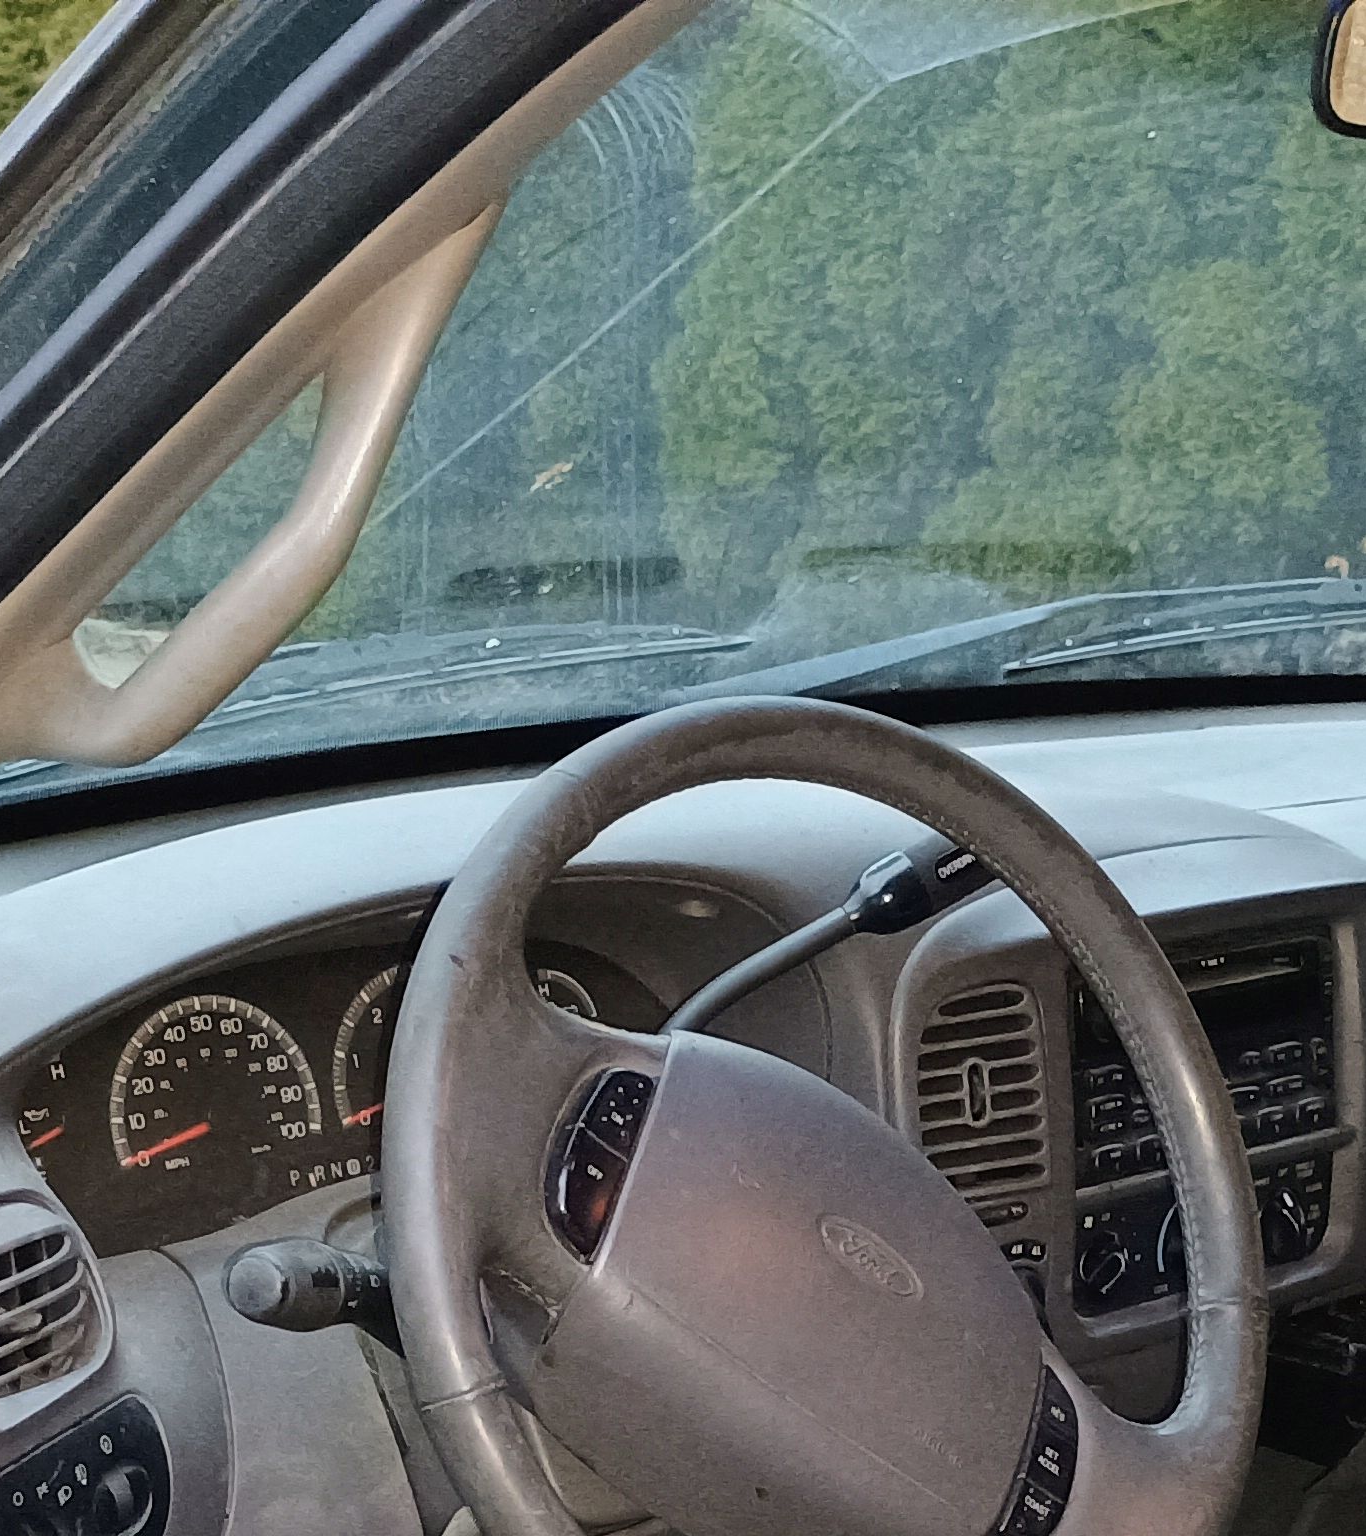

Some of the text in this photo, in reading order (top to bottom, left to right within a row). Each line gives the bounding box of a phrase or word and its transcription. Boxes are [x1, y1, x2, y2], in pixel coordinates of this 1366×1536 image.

[190, 1014, 212, 1032] 50
[371, 1007, 383, 1024] 2
[163, 1025, 185, 1043] 40
[220, 1018, 242, 1035] 60
[247, 1033, 269, 1050] 70
[143, 1048, 166, 1067] 30
[266, 1055, 288, 1072] 80
[352, 1053, 360, 1069] 1
[50, 1063, 66, 1081] H
[132, 1077, 154, 1095] 20
[280, 1085, 302, 1103] 90
[129, 1113, 146, 1130] 10
[359, 1109, 371, 1126] 0
[280, 1121, 306, 1139] 100
[137, 1150, 151, 1167] 0
[165, 1156, 190, 1170] MPH
[289, 1169, 301, 1187] P
[330, 1161, 343, 1179] N
